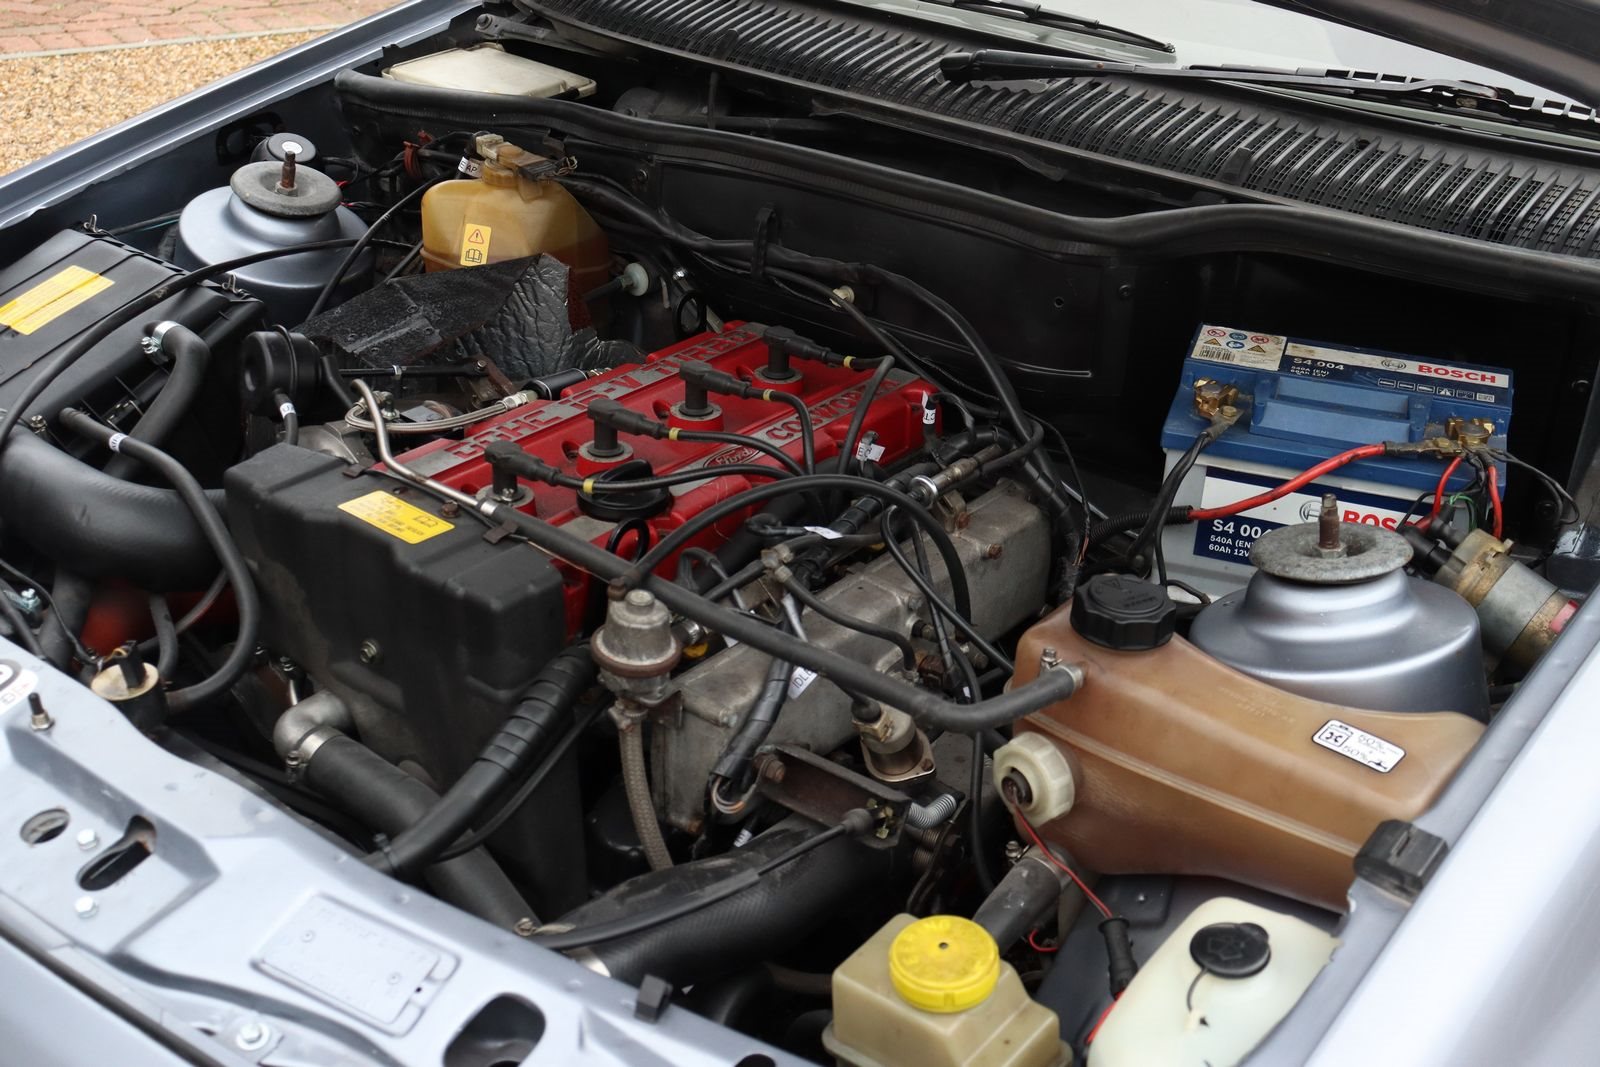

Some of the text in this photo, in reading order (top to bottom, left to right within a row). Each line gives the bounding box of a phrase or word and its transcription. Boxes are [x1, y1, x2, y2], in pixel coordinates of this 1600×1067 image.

[1294, 357, 1344, 370] S4 004
[1418, 364, 1496, 383] BOSCH
[1212, 519, 1235, 534] S4
[1210, 535, 1233, 545] 540A
[1208, 544, 1250, 557] 60Ah 12V
